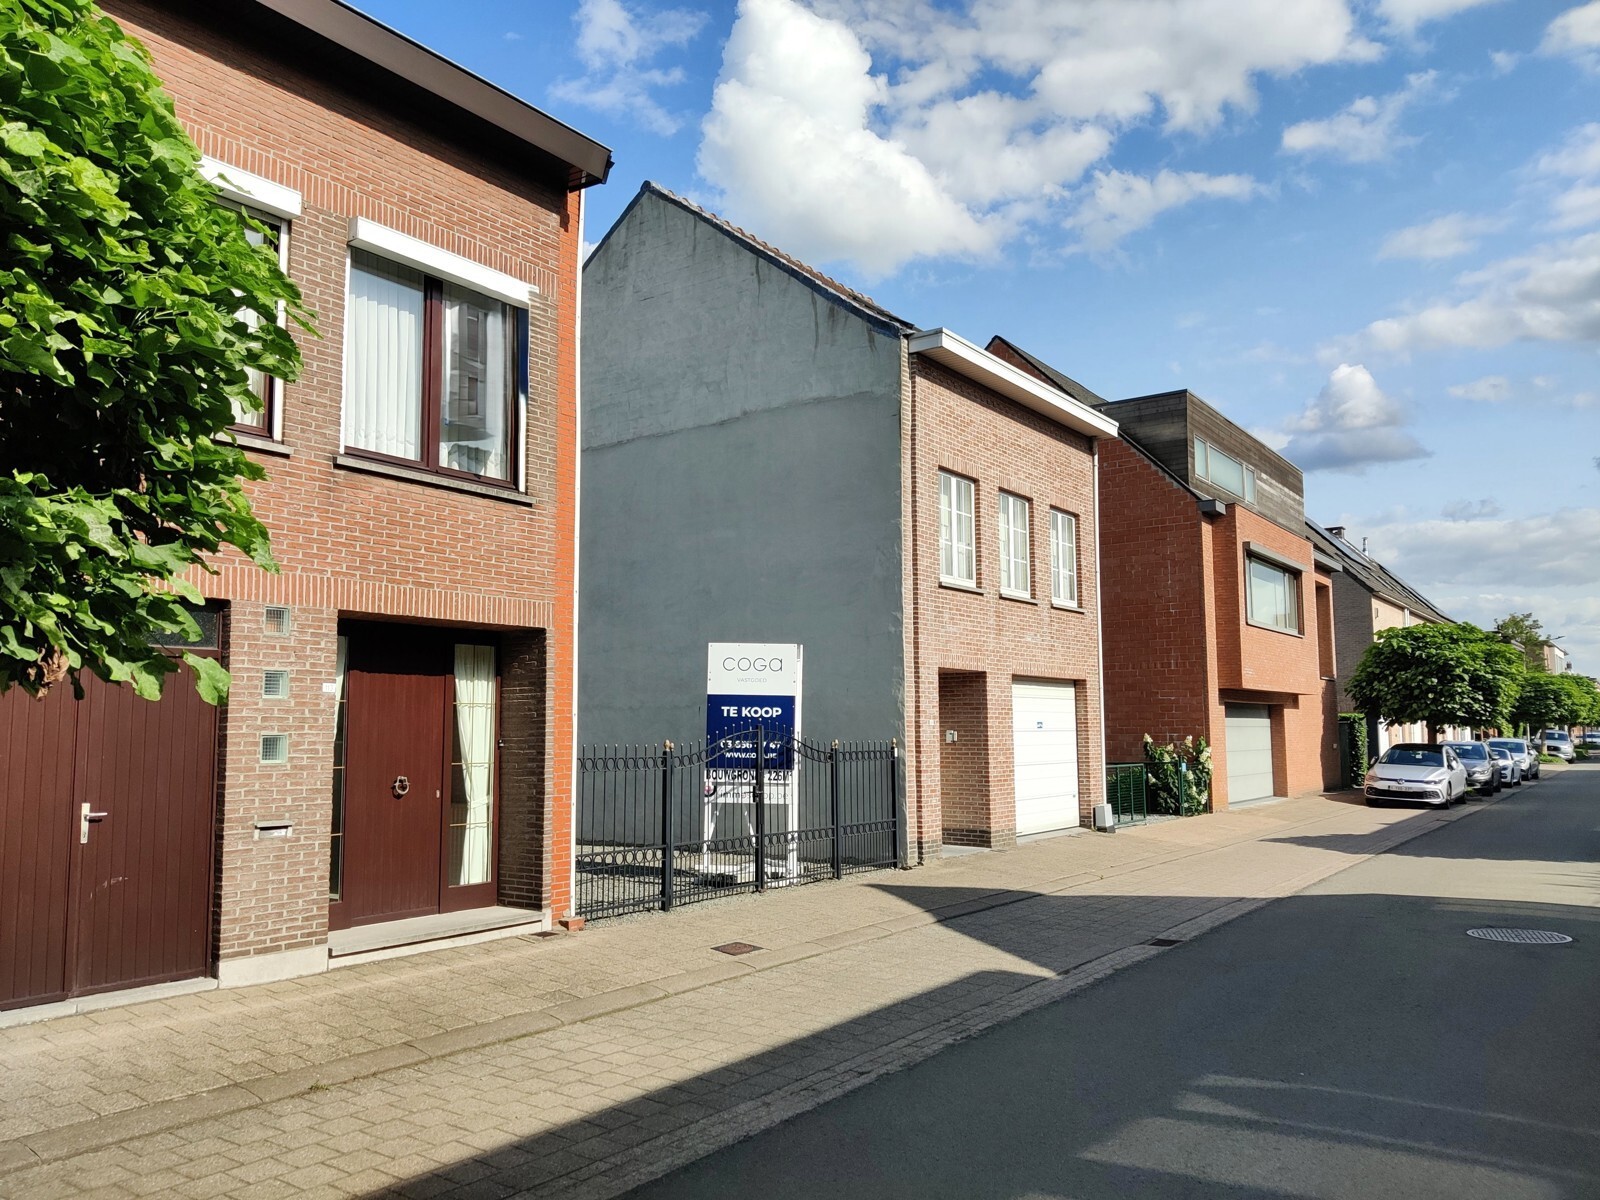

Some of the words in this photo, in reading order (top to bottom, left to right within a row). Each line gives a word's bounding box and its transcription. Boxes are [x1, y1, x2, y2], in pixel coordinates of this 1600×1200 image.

[721, 706, 738, 717] TE
[741, 706, 782, 718] KOOP
[706, 769, 758, 781] BOUWGRON
